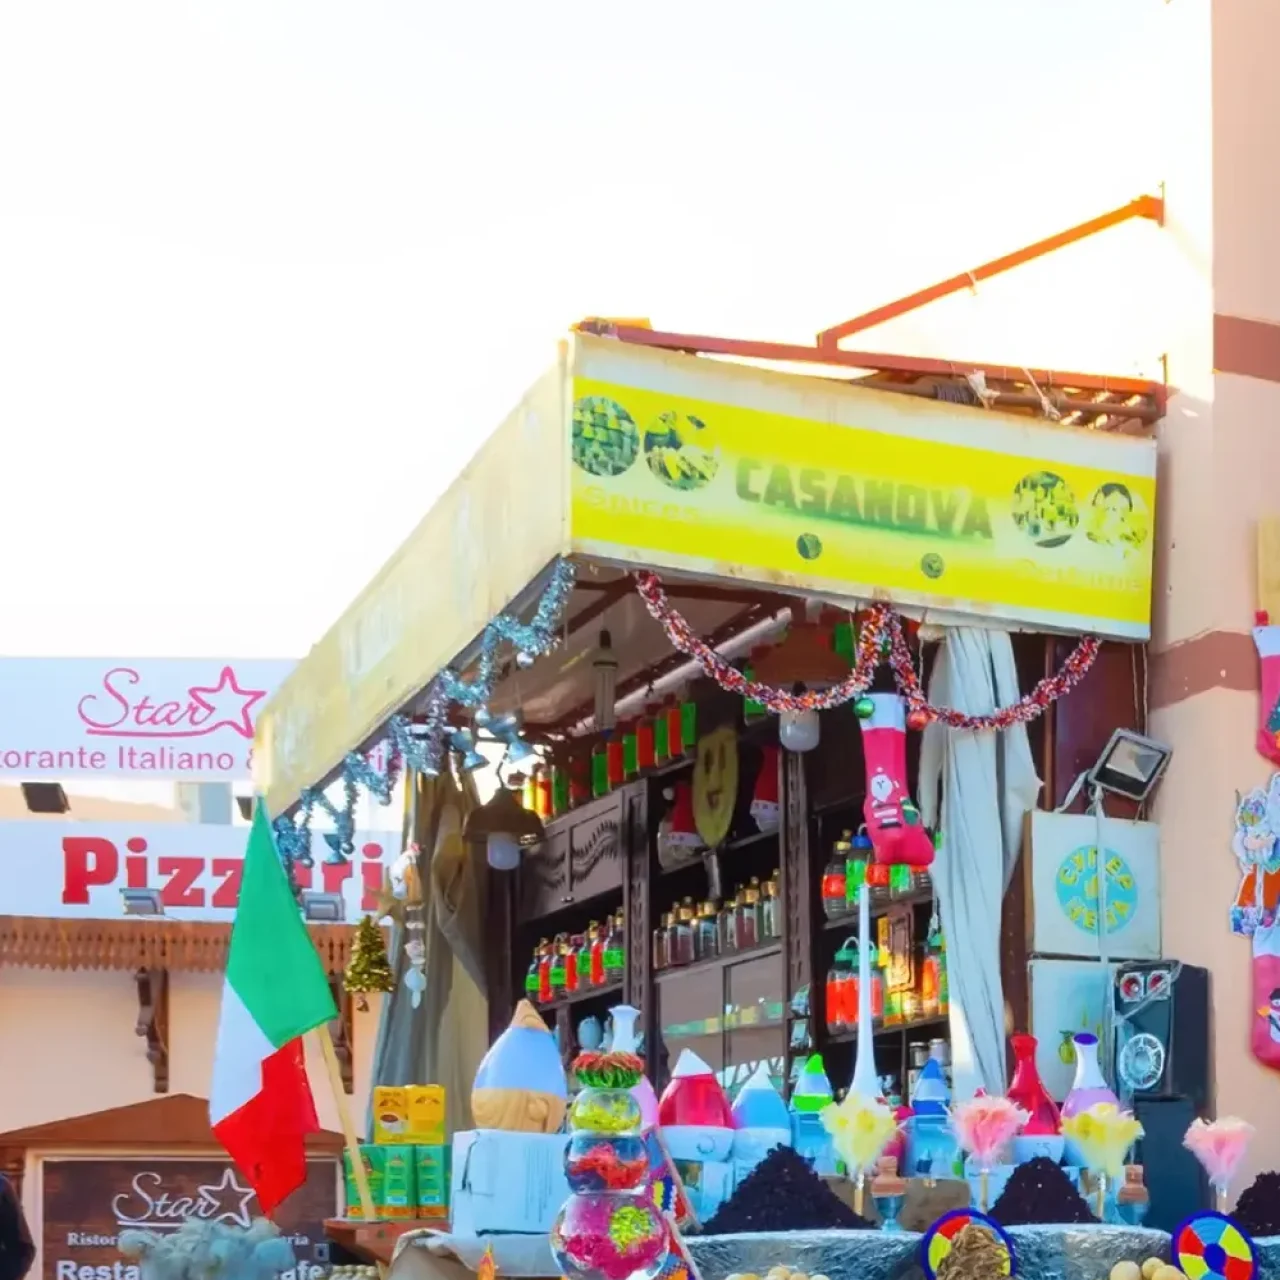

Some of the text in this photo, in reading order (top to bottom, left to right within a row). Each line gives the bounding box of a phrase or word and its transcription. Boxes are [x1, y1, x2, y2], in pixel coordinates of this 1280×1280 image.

[734, 456, 994, 540] CASANOVA
[77, 667, 216, 729] Star
[0, 746, 107, 770] orante
[118, 746, 235, 771] Italiano
[111, 1171, 219, 1222] Star
[67, 1233, 119, 1247] Ristor
